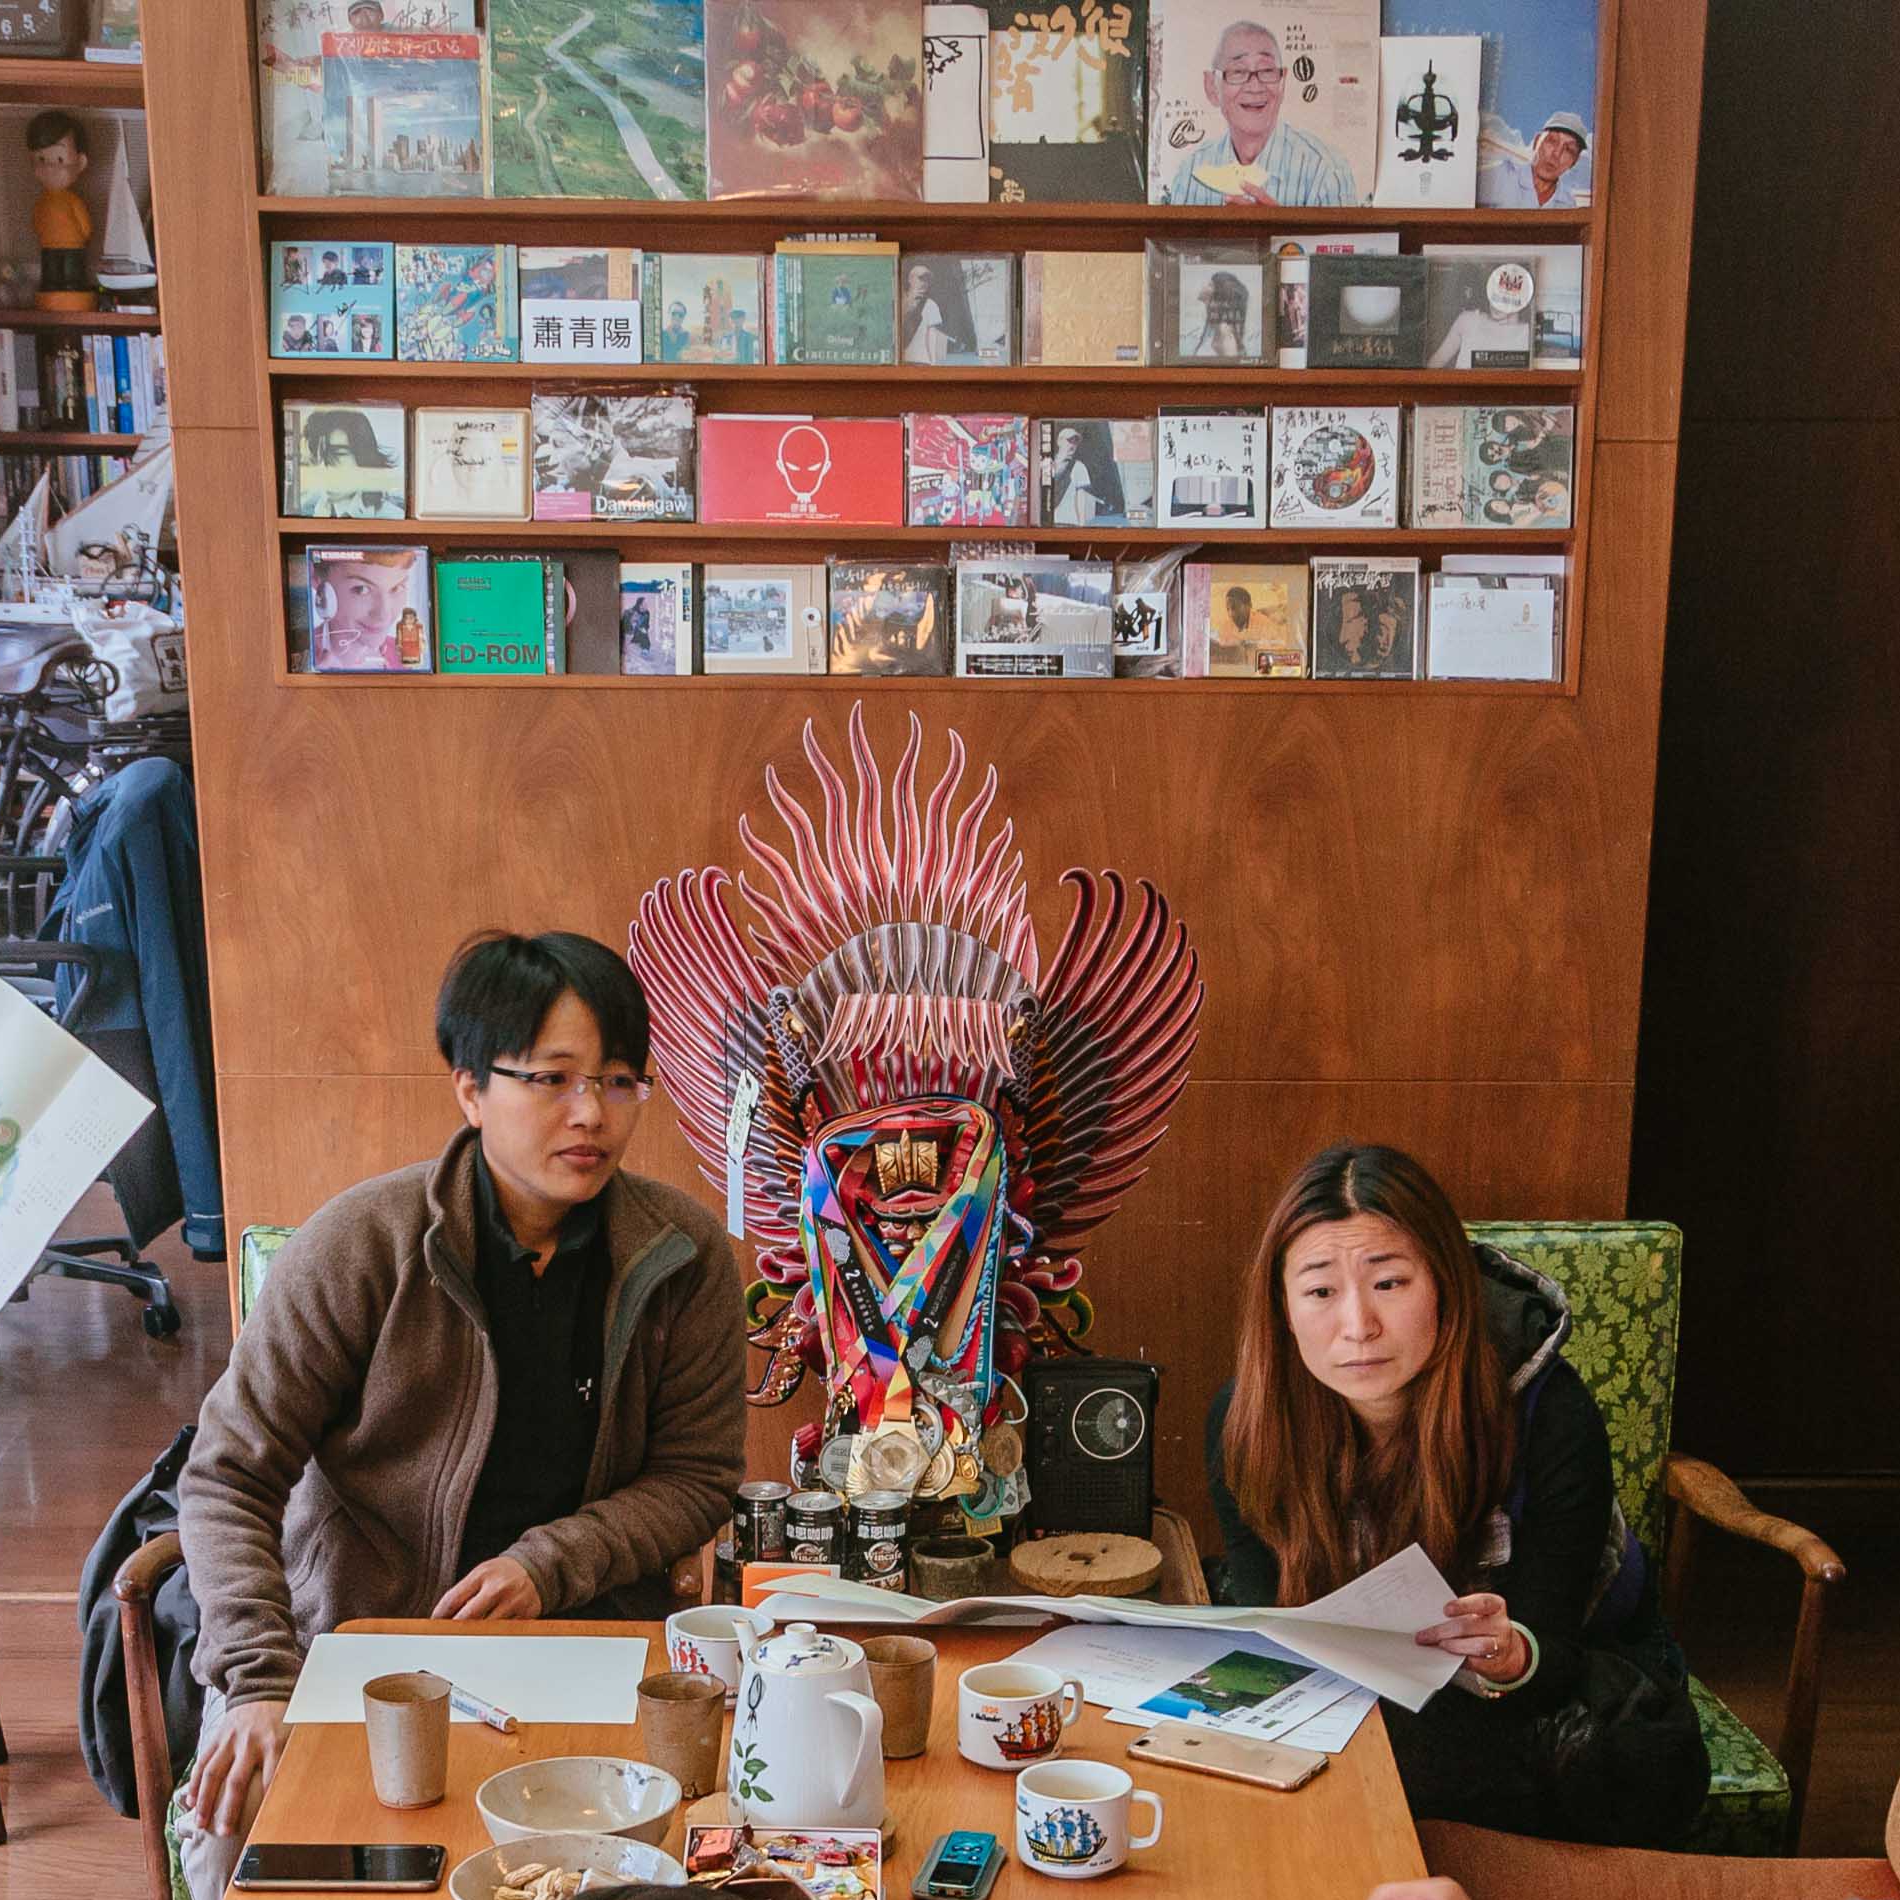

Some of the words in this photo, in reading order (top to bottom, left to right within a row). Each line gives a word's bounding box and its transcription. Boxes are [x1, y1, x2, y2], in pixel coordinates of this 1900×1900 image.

[1, 18, 12, 34] 6
[23, 14, 34, 31] 5
[533, 315, 632, 349] 蕭青陽
[595, 494, 688, 516] Damalagaw
[444, 643, 540, 665] CD-ROM
[790, 1550, 828, 1563] Wincafe
[864, 1549, 903, 1562] Wincafe
